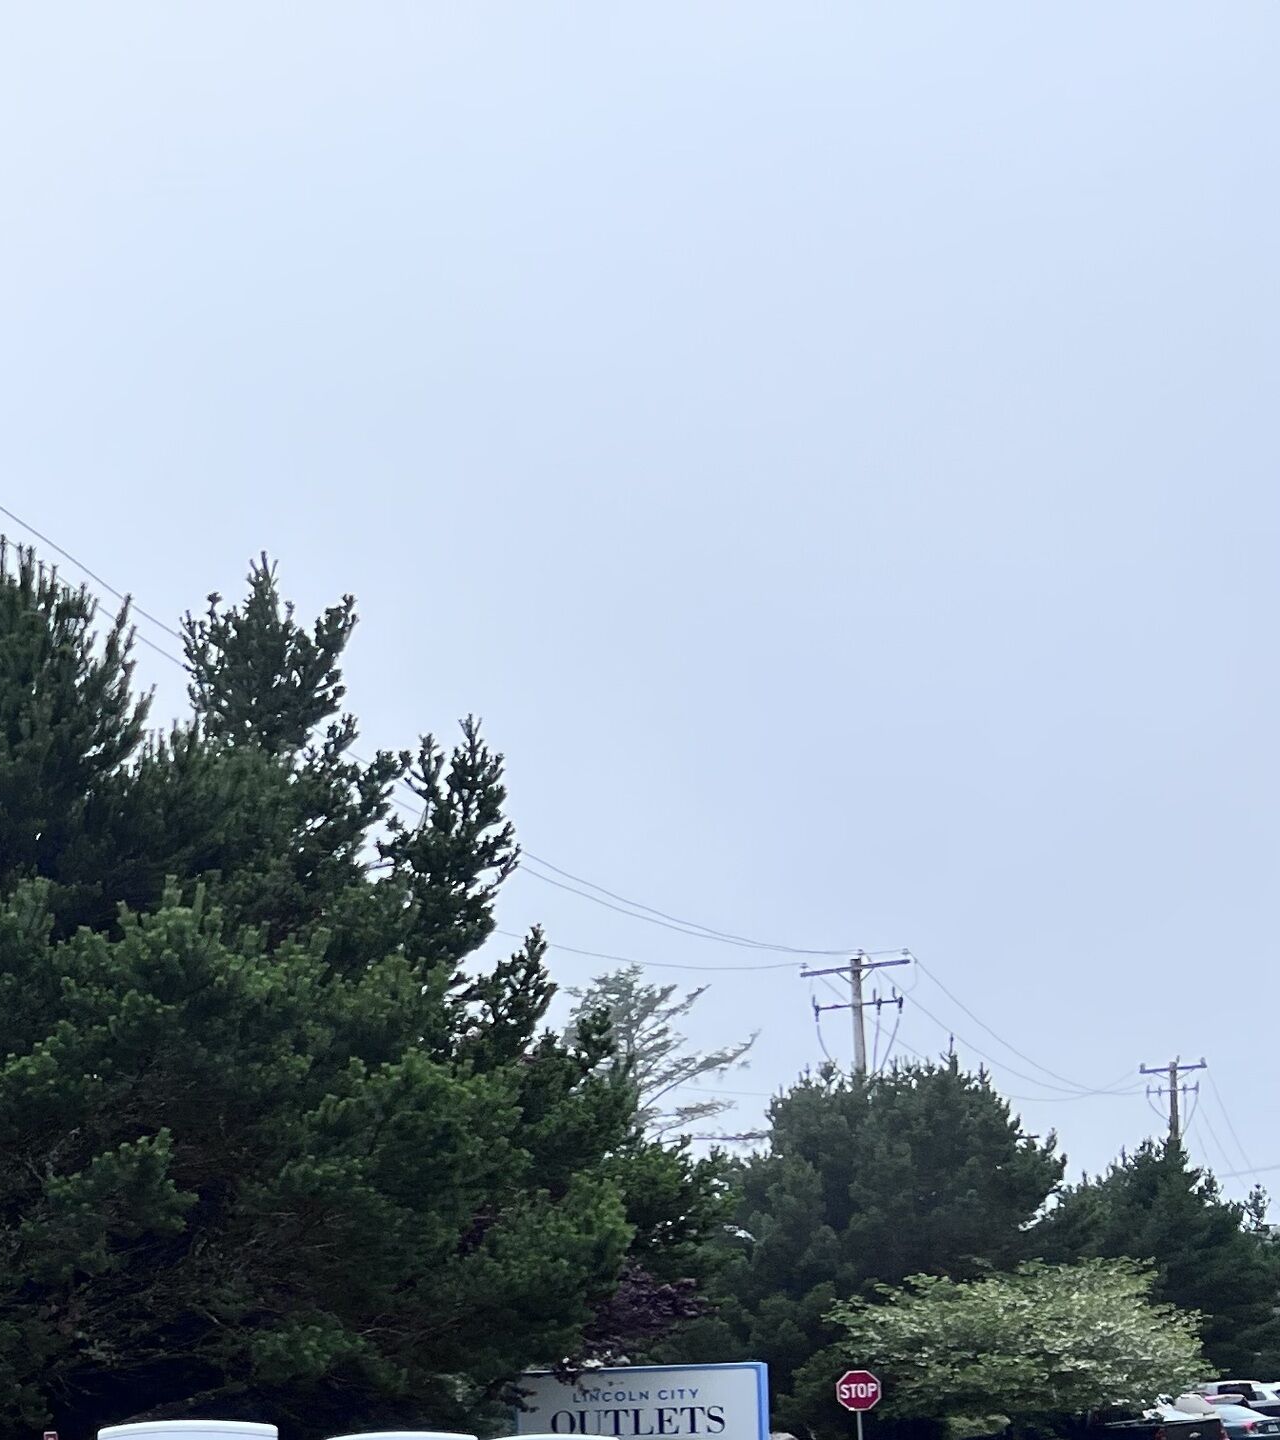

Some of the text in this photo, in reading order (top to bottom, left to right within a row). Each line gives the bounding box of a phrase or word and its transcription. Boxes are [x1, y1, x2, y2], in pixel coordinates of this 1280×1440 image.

[572, 1388, 700, 1403] LINCOLN CITY
[840, 1383, 877, 1399] STOP
[550, 1405, 727, 1436] OUTLETS
